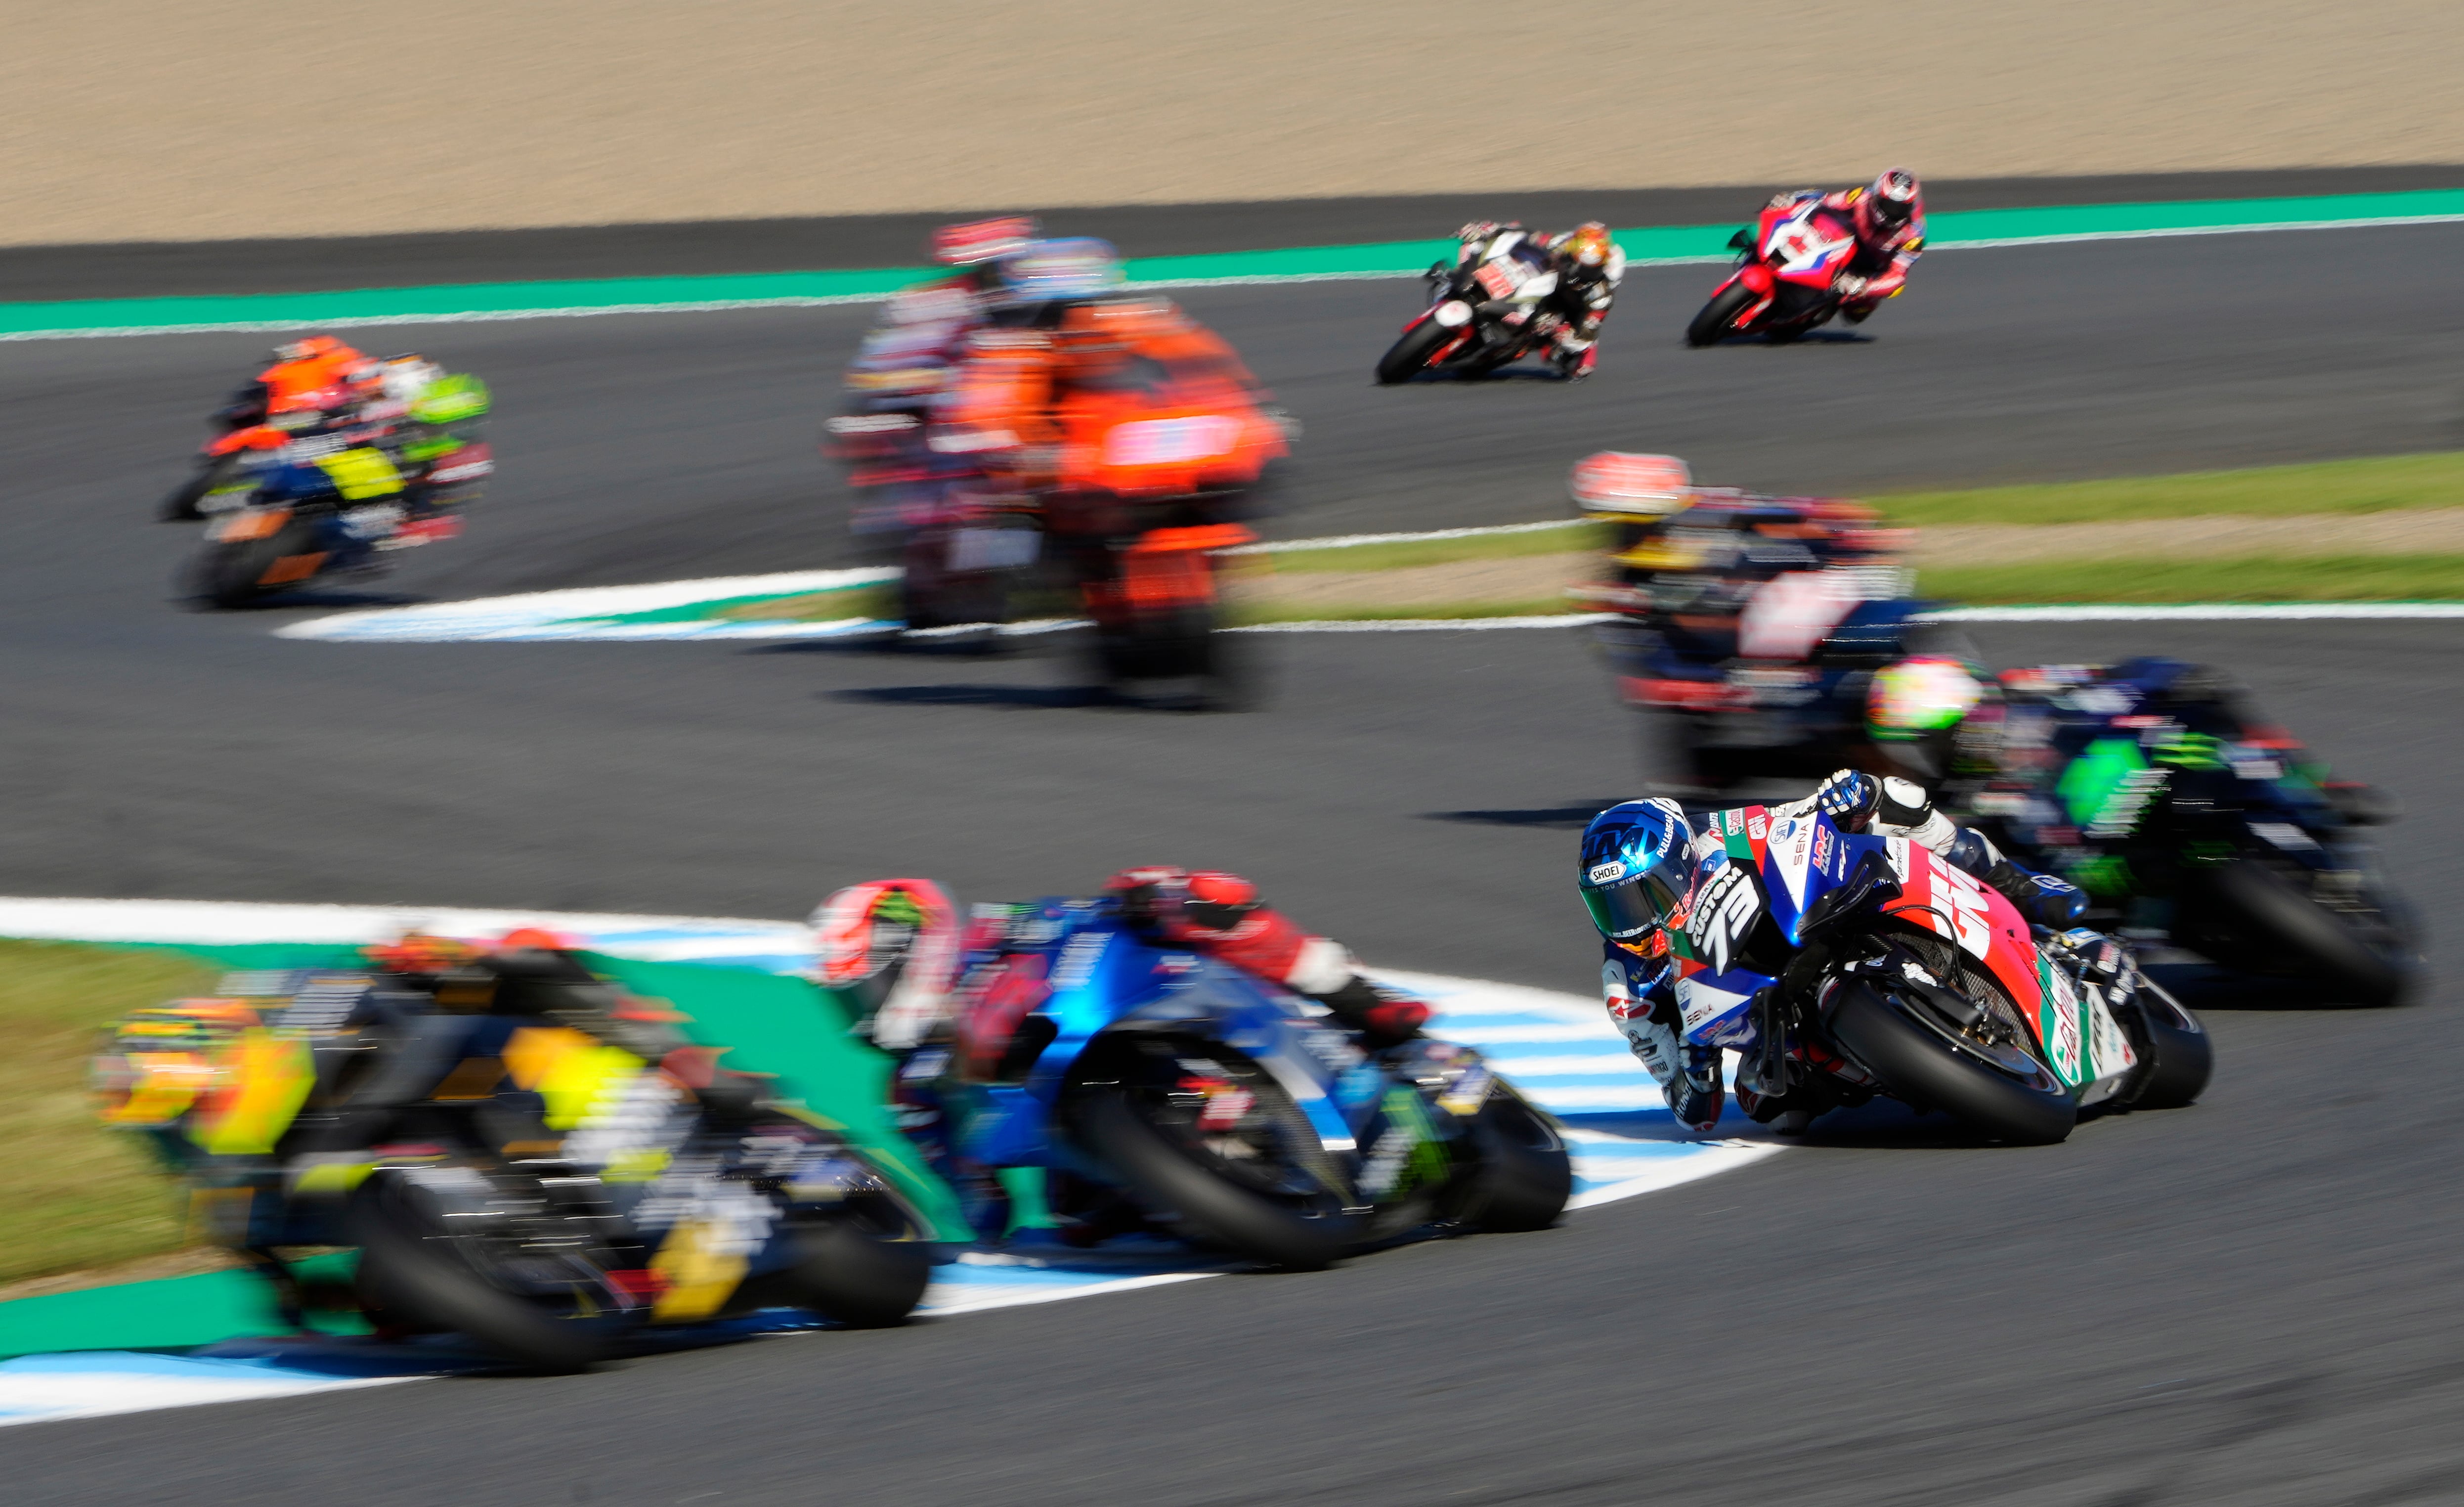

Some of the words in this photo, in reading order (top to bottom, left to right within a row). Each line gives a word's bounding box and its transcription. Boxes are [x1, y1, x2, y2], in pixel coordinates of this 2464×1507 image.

[1656, 814, 1674, 859] PULL&BEAR
[1794, 823, 1810, 865] SENA
[1593, 866, 1619, 881] SHOEI
[1618, 872, 1646, 886] WINGS
[1692, 866, 1743, 947] CUSTOM
[1701, 875, 1760, 977] 73
